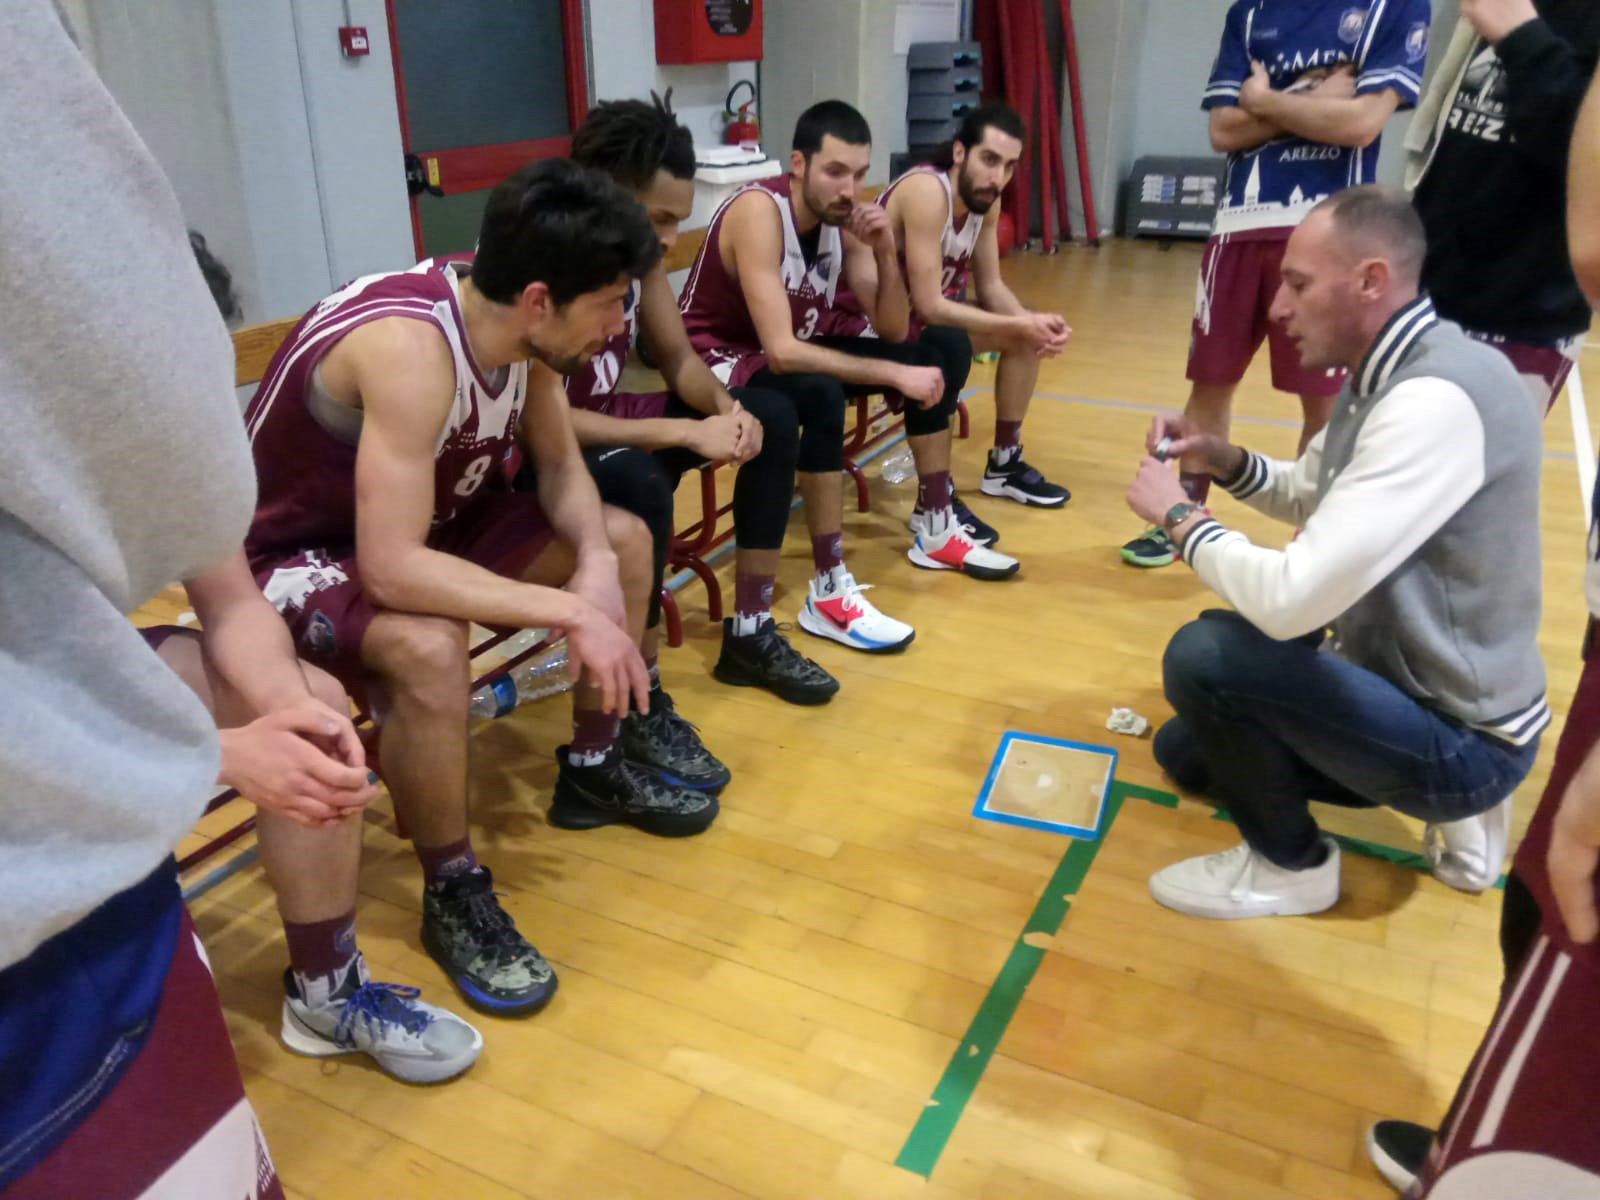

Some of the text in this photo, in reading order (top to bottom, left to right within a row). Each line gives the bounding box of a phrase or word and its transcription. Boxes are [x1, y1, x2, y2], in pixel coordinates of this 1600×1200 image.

[1279, 146, 1341, 163] AREZZO
[797, 307, 819, 340] 3
[454, 455, 492, 496] 8
